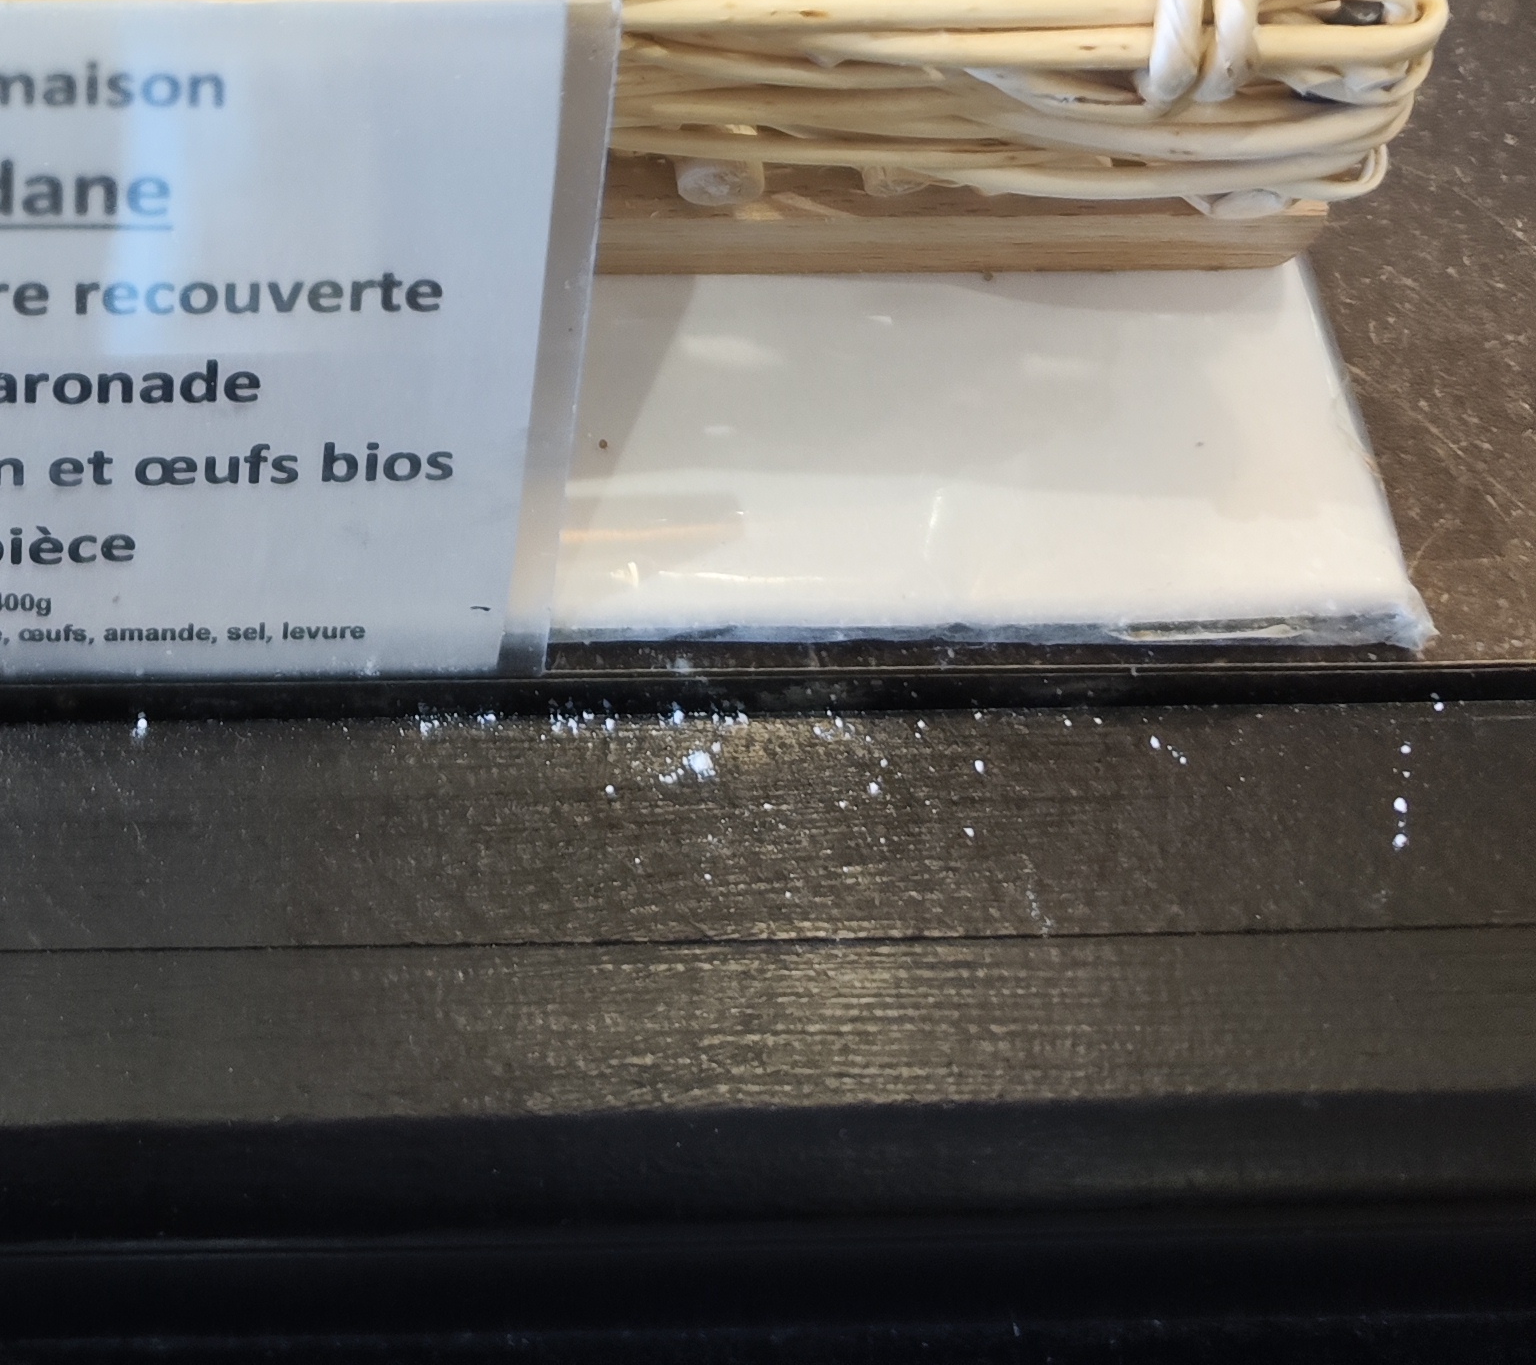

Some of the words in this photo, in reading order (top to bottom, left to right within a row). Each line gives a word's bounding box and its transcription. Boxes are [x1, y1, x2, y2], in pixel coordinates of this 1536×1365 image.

[74, 270, 443, 317] recouverte
[48, 450, 114, 488] et
[134, 443, 299, 487] œufs
[321, 441, 454, 485] bios
[18, 624, 95, 645] œufs,
[103, 622, 218, 645] amande,
[226, 621, 273, 644] sel,
[281, 621, 366, 643] levure
